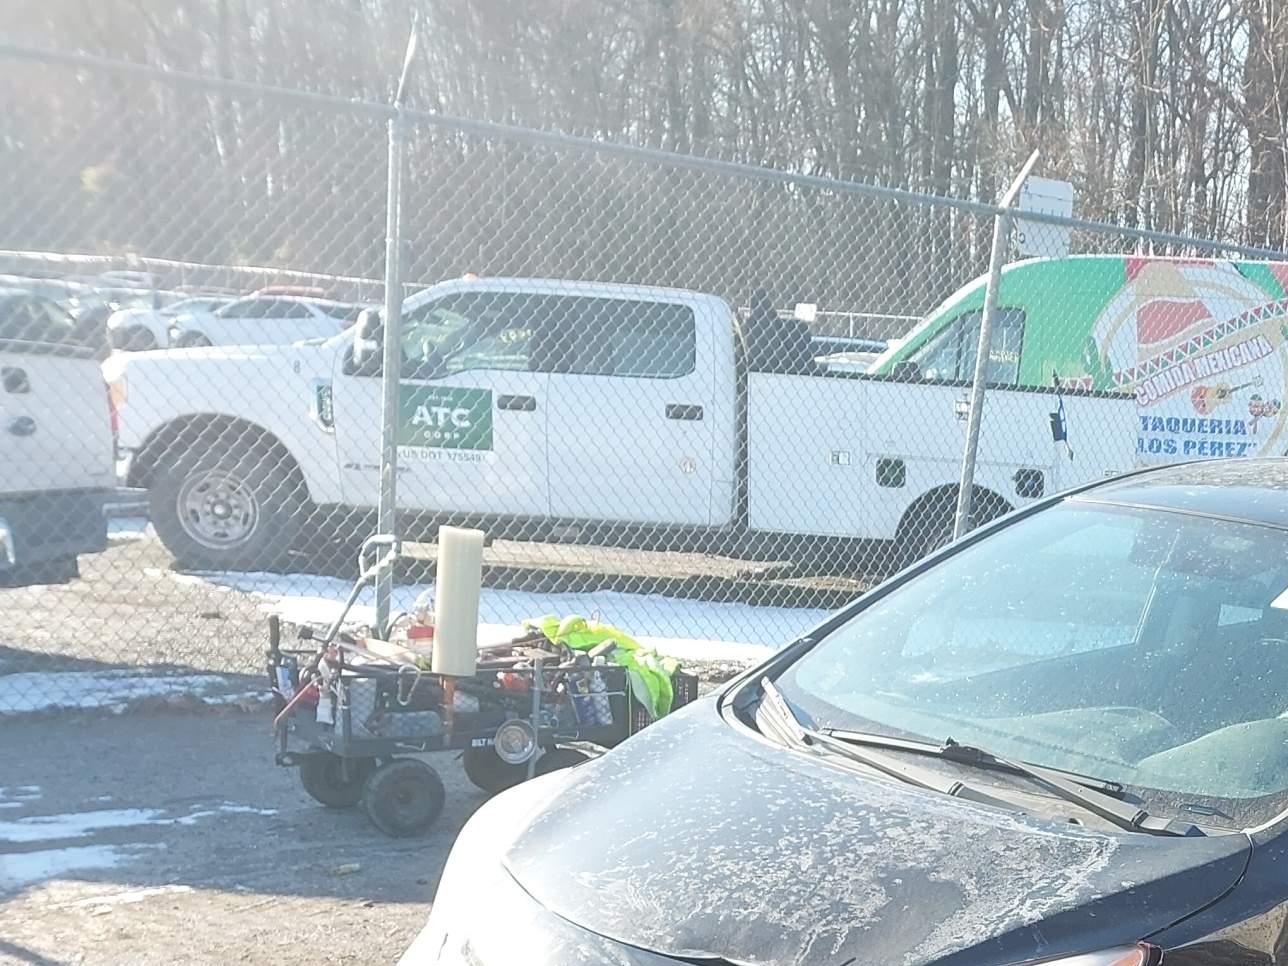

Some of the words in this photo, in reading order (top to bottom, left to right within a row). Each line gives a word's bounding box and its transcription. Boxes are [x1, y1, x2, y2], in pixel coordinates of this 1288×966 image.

[1135, 360, 1195, 407] COMIDA
[1196, 334, 1273, 380] MEXICANA
[412, 405, 471, 428] ATC
[1139, 416, 1248, 435] TAQUERIA
[424, 431, 460, 439] CORP
